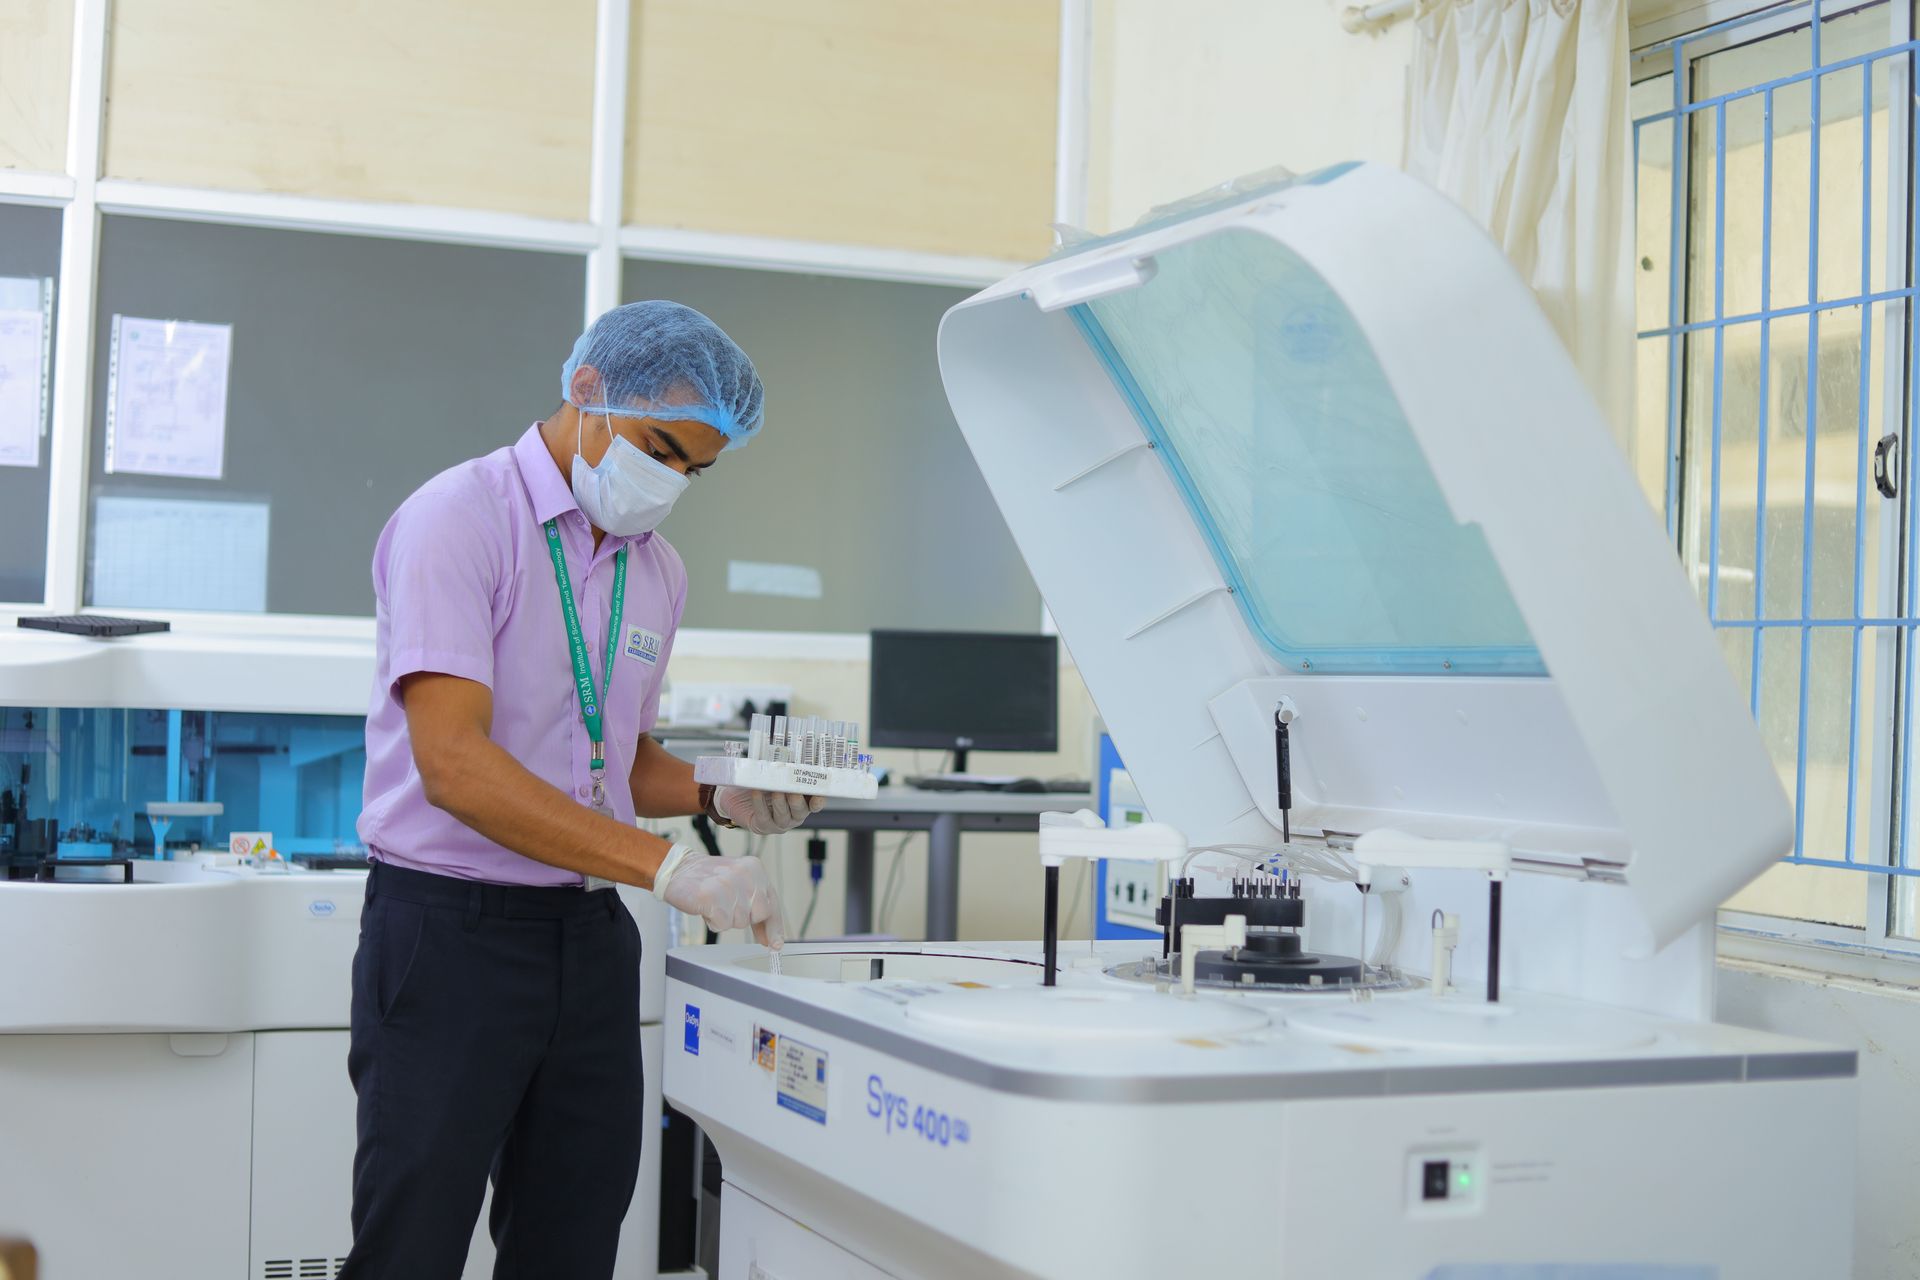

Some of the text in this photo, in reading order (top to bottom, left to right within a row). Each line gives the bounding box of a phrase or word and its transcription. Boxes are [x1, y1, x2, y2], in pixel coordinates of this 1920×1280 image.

[616, 561, 624, 599] Technology
[555, 547, 594, 703] SRM Institute of Science and Technology
[644, 635, 659, 652] SRM
[867, 1075, 908, 1135] Sys
[912, 1104, 951, 1147] 400
